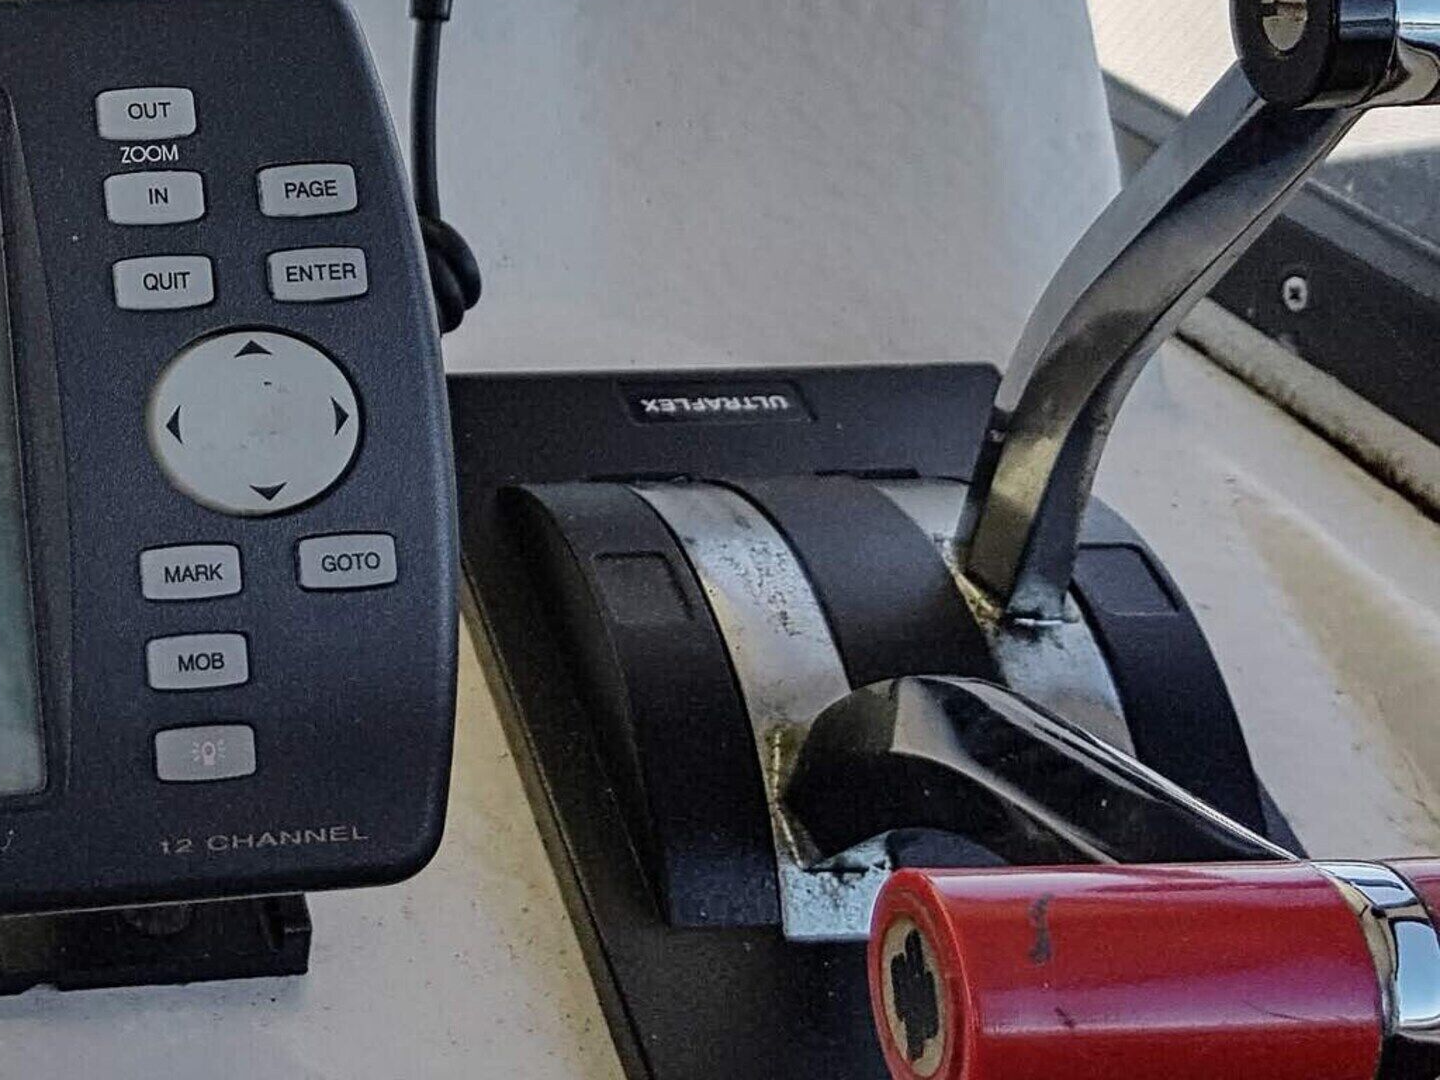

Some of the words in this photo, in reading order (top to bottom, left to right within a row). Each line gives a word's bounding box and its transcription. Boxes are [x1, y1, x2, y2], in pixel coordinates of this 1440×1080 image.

[127, 102, 171, 120] OUT
[120, 145, 179, 164] ZOOM
[148, 187, 169, 205] IN
[284, 180, 338, 199] PAGE
[143, 272, 191, 291] QUIT
[286, 263, 357, 283] ENTER
[641, 395, 789, 412] ULTRAFLEX
[321, 552, 381, 573] GOTO
[163, 563, 224, 583] MARK
[177, 652, 225, 672] MOB
[160, 839, 193, 856] 12
[208, 825, 370, 851] CHANNEL
